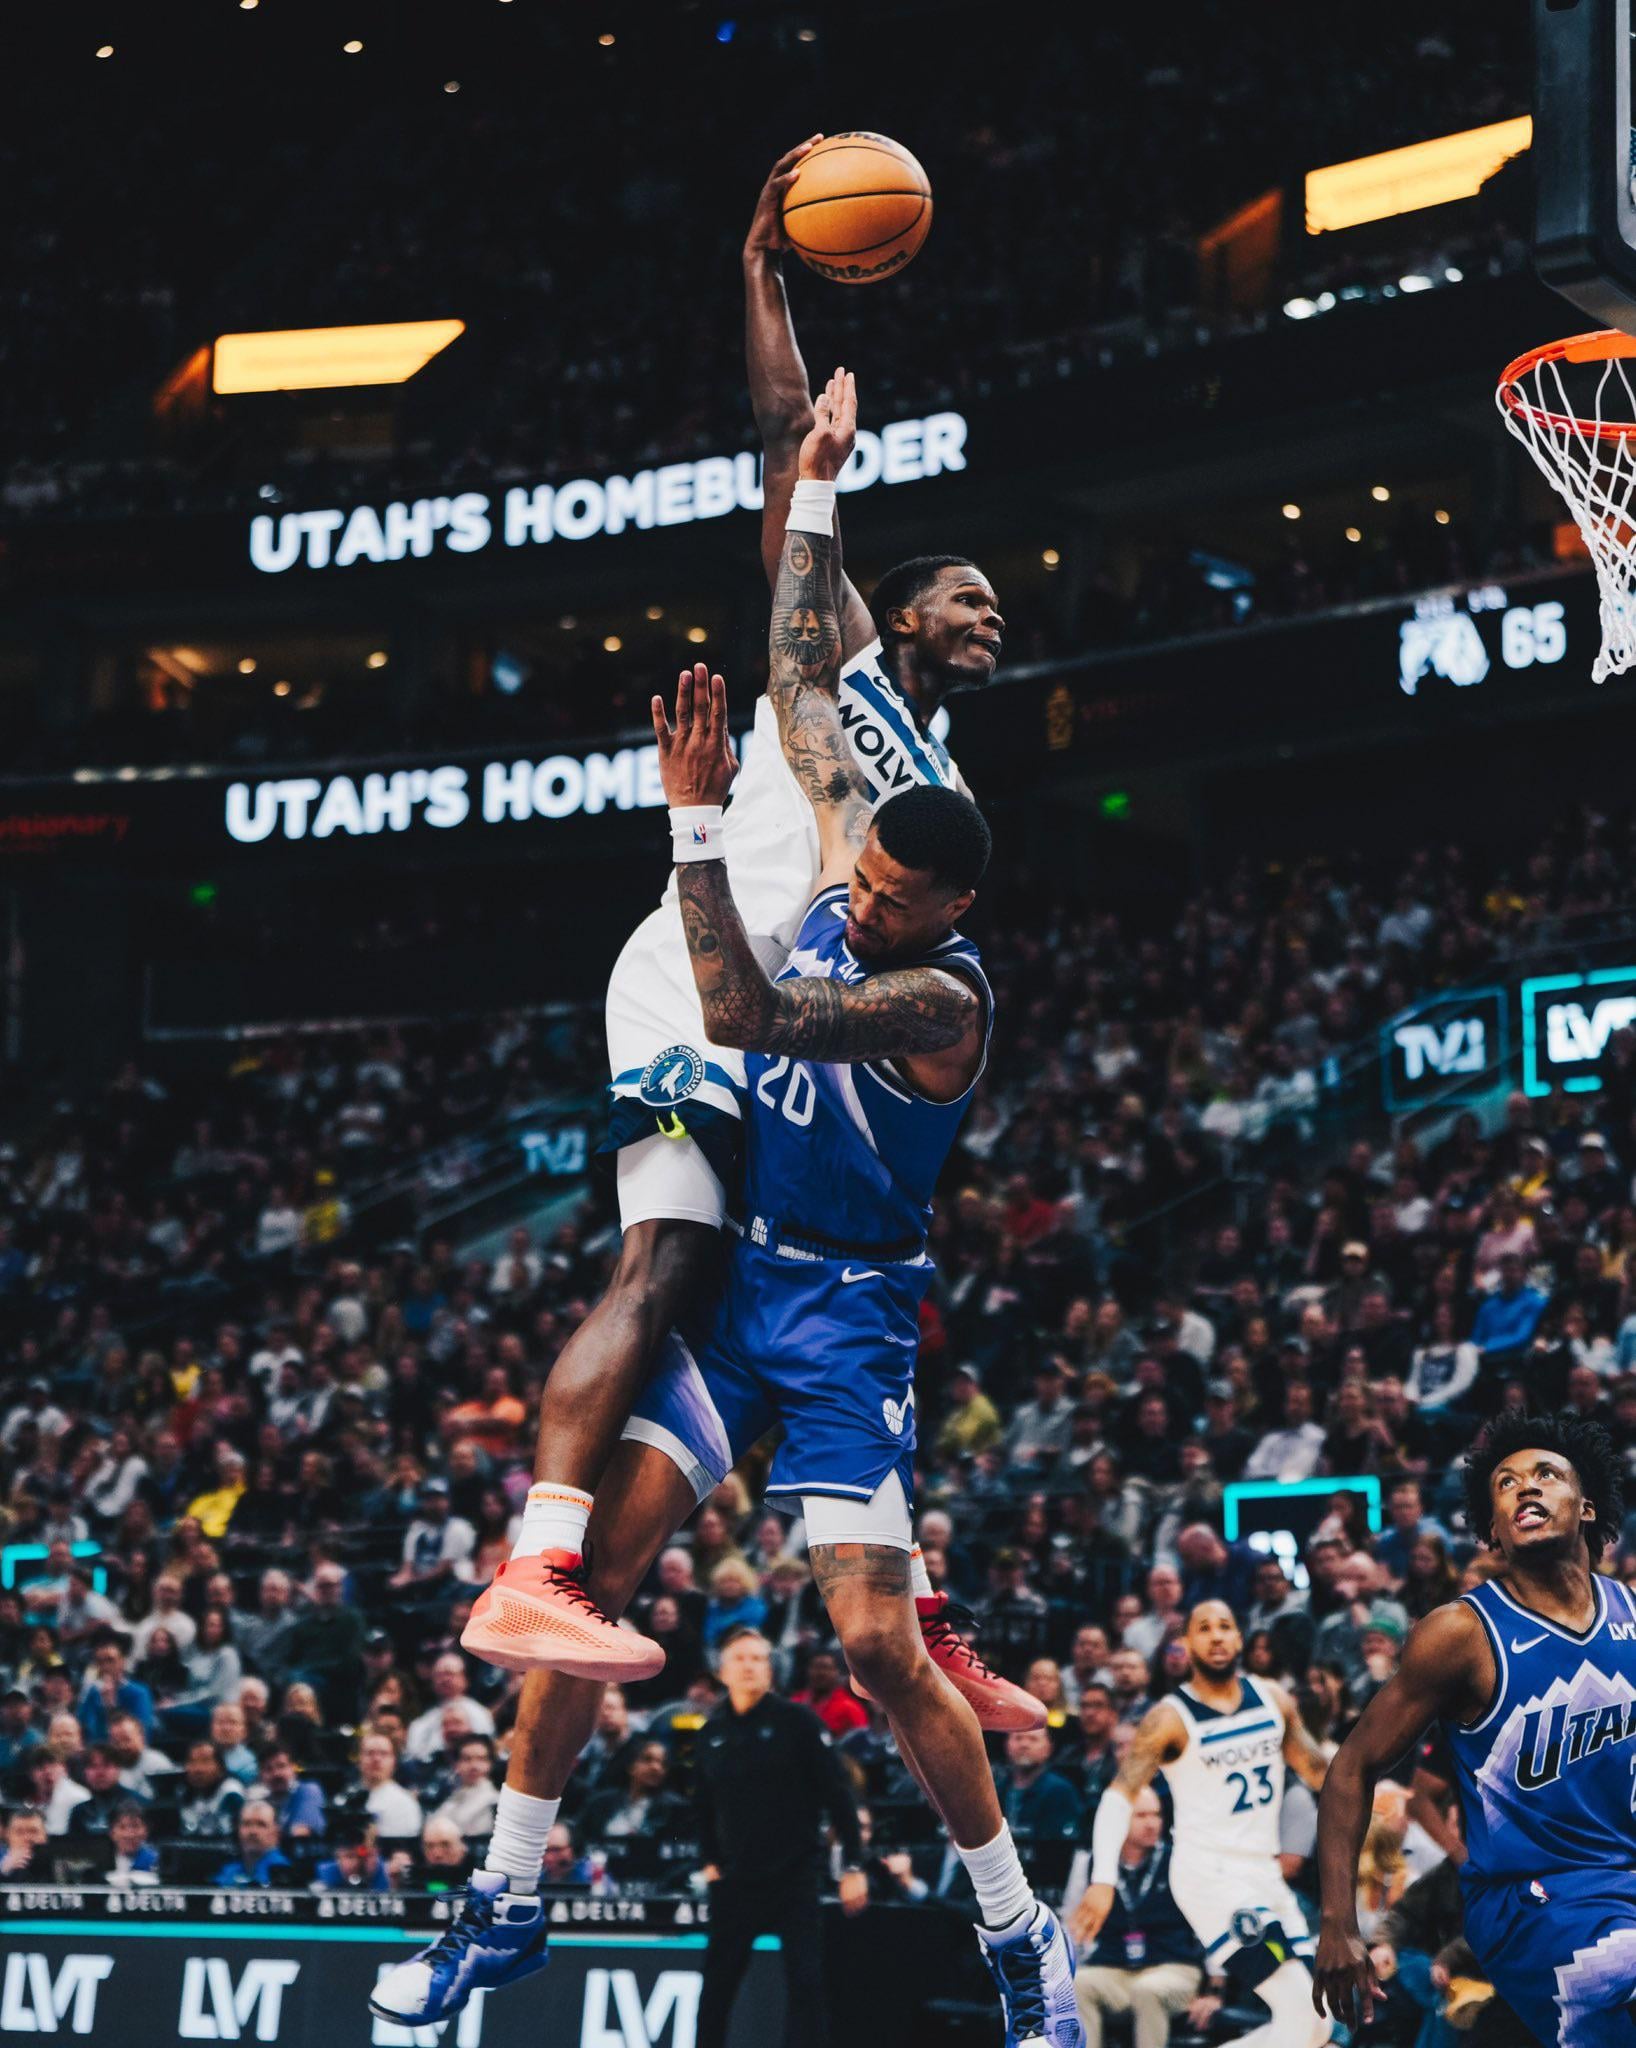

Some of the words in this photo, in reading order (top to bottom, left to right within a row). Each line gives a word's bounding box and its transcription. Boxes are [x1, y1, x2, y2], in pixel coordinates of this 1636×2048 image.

[250, 491, 491, 573] UTAH'S
[504, 411, 968, 547] HOMEBUDER
[1501, 601, 1567, 669] 65
[838, 703, 914, 789] WOLV
[225, 765, 470, 843] UTAH'S
[757, 1054, 817, 1127] 20
[1515, 1701, 1636, 1792] UTA
[1224, 1763, 1274, 1814] 23
[572, 1900, 645, 1921] DELTA
[0, 1951, 116, 2035] LVT
[178, 1956, 301, 2042] LVT
